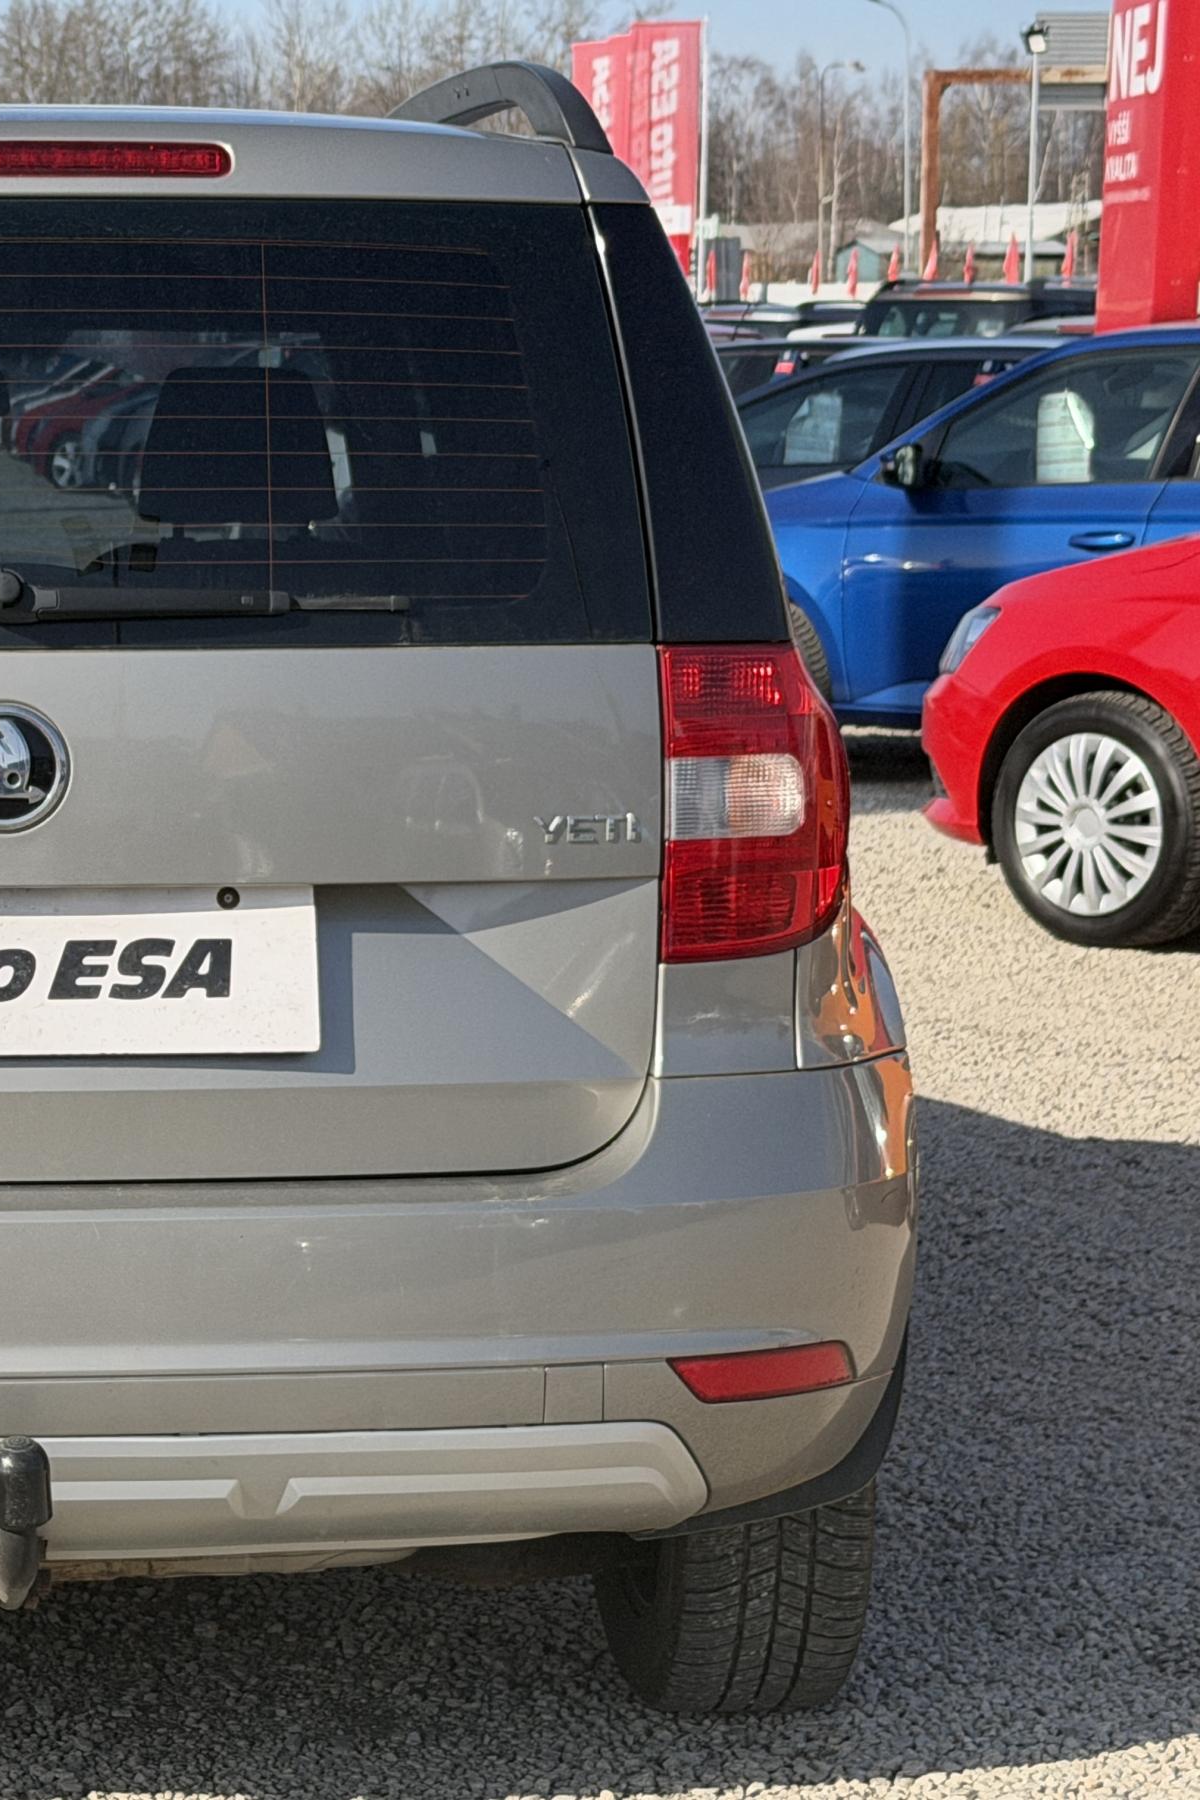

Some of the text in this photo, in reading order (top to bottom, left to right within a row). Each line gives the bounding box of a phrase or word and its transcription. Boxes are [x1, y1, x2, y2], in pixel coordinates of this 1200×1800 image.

[1109, 0, 1168, 102] NEJ
[533, 813, 641, 843] YETI
[47, 938, 232, 1000] ESA
